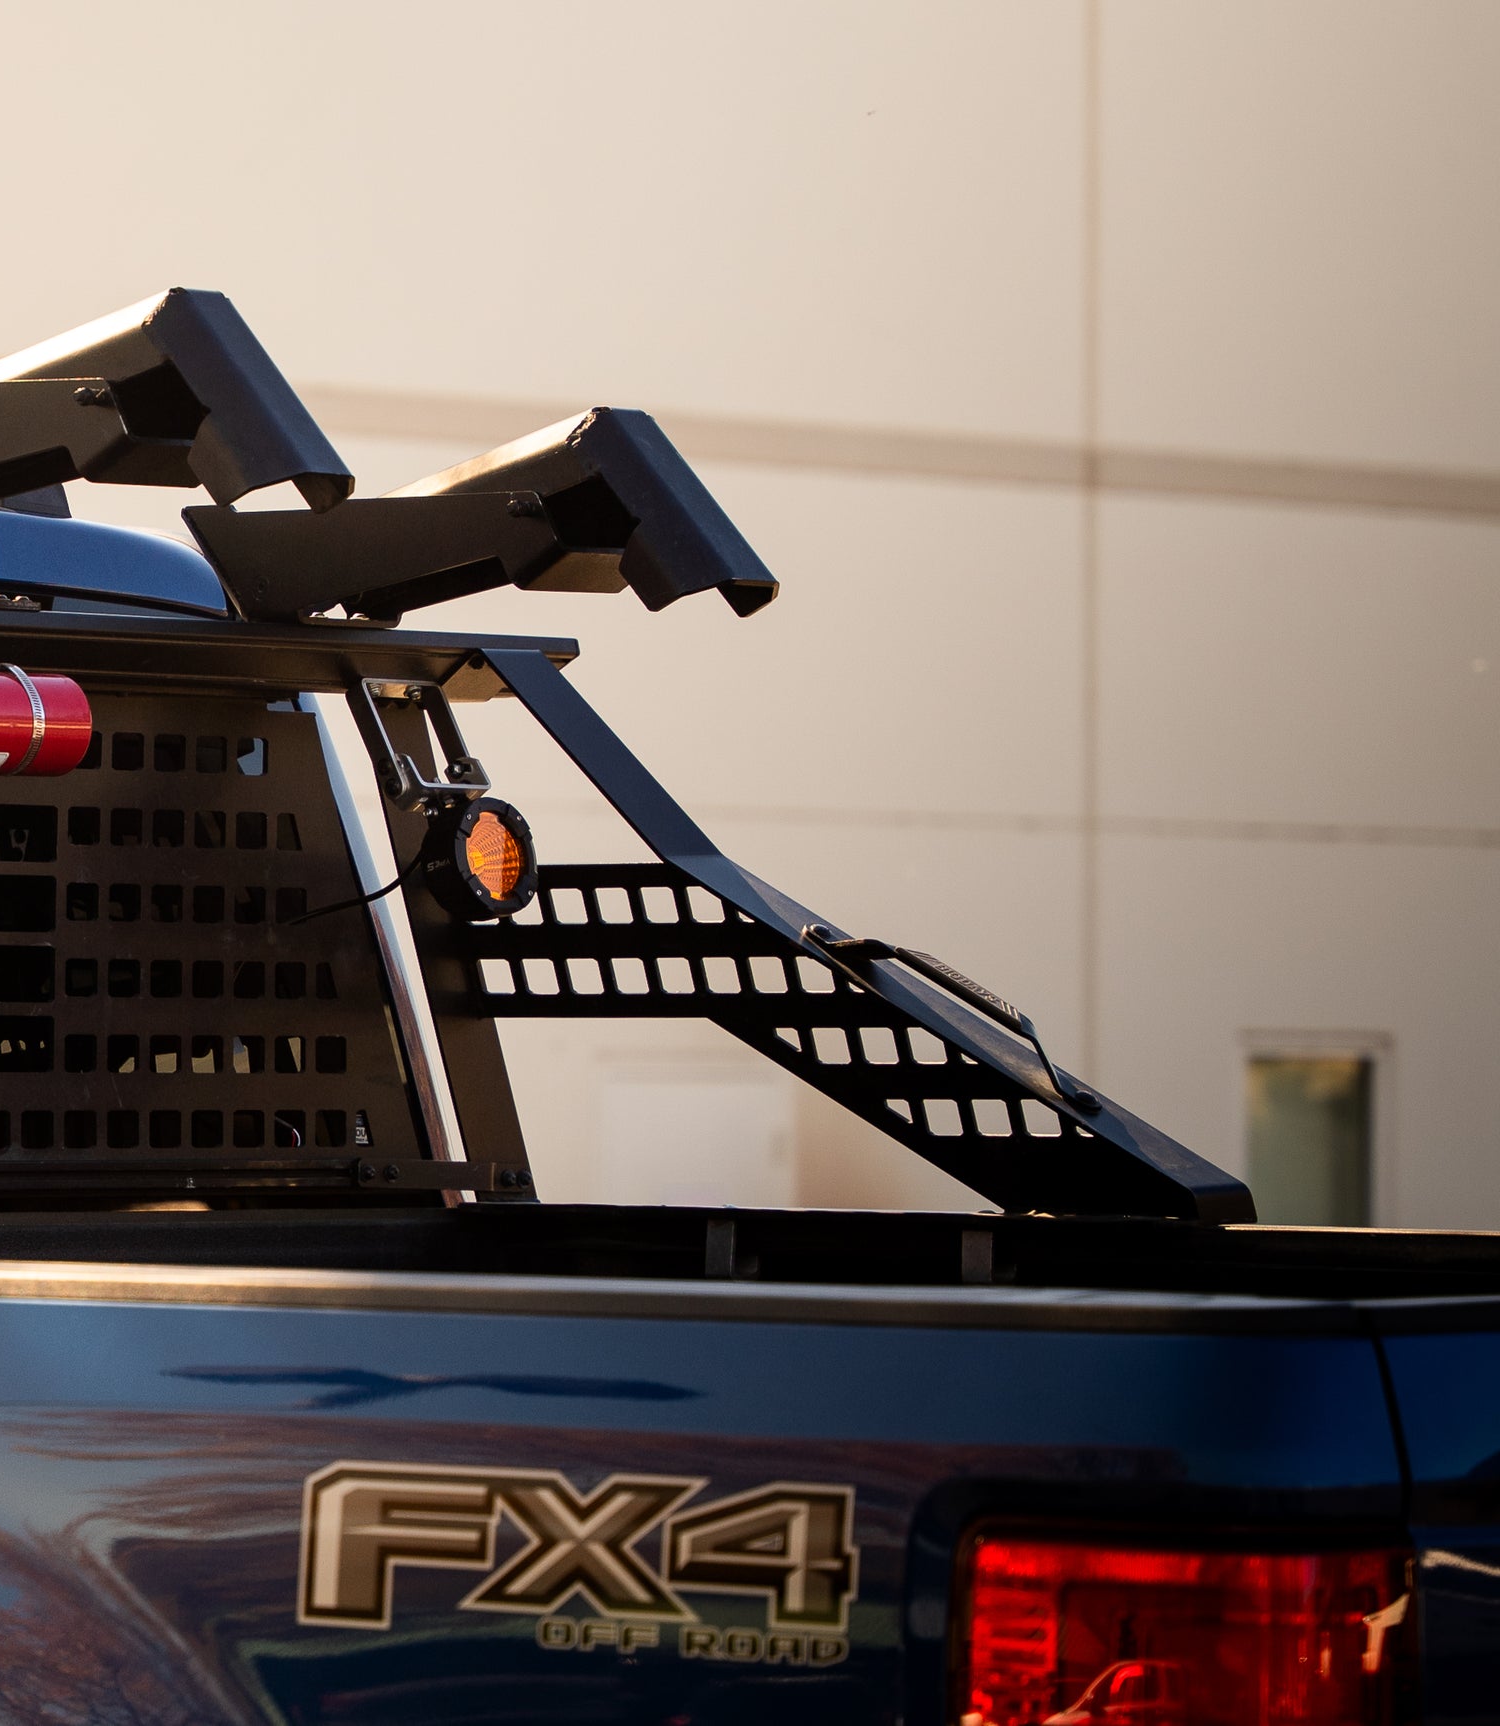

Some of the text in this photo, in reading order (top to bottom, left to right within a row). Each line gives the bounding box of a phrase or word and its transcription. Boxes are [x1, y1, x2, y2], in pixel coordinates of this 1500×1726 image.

[298, 1460, 859, 1629] FX4
[537, 1614, 850, 1666] OFF ROAD
